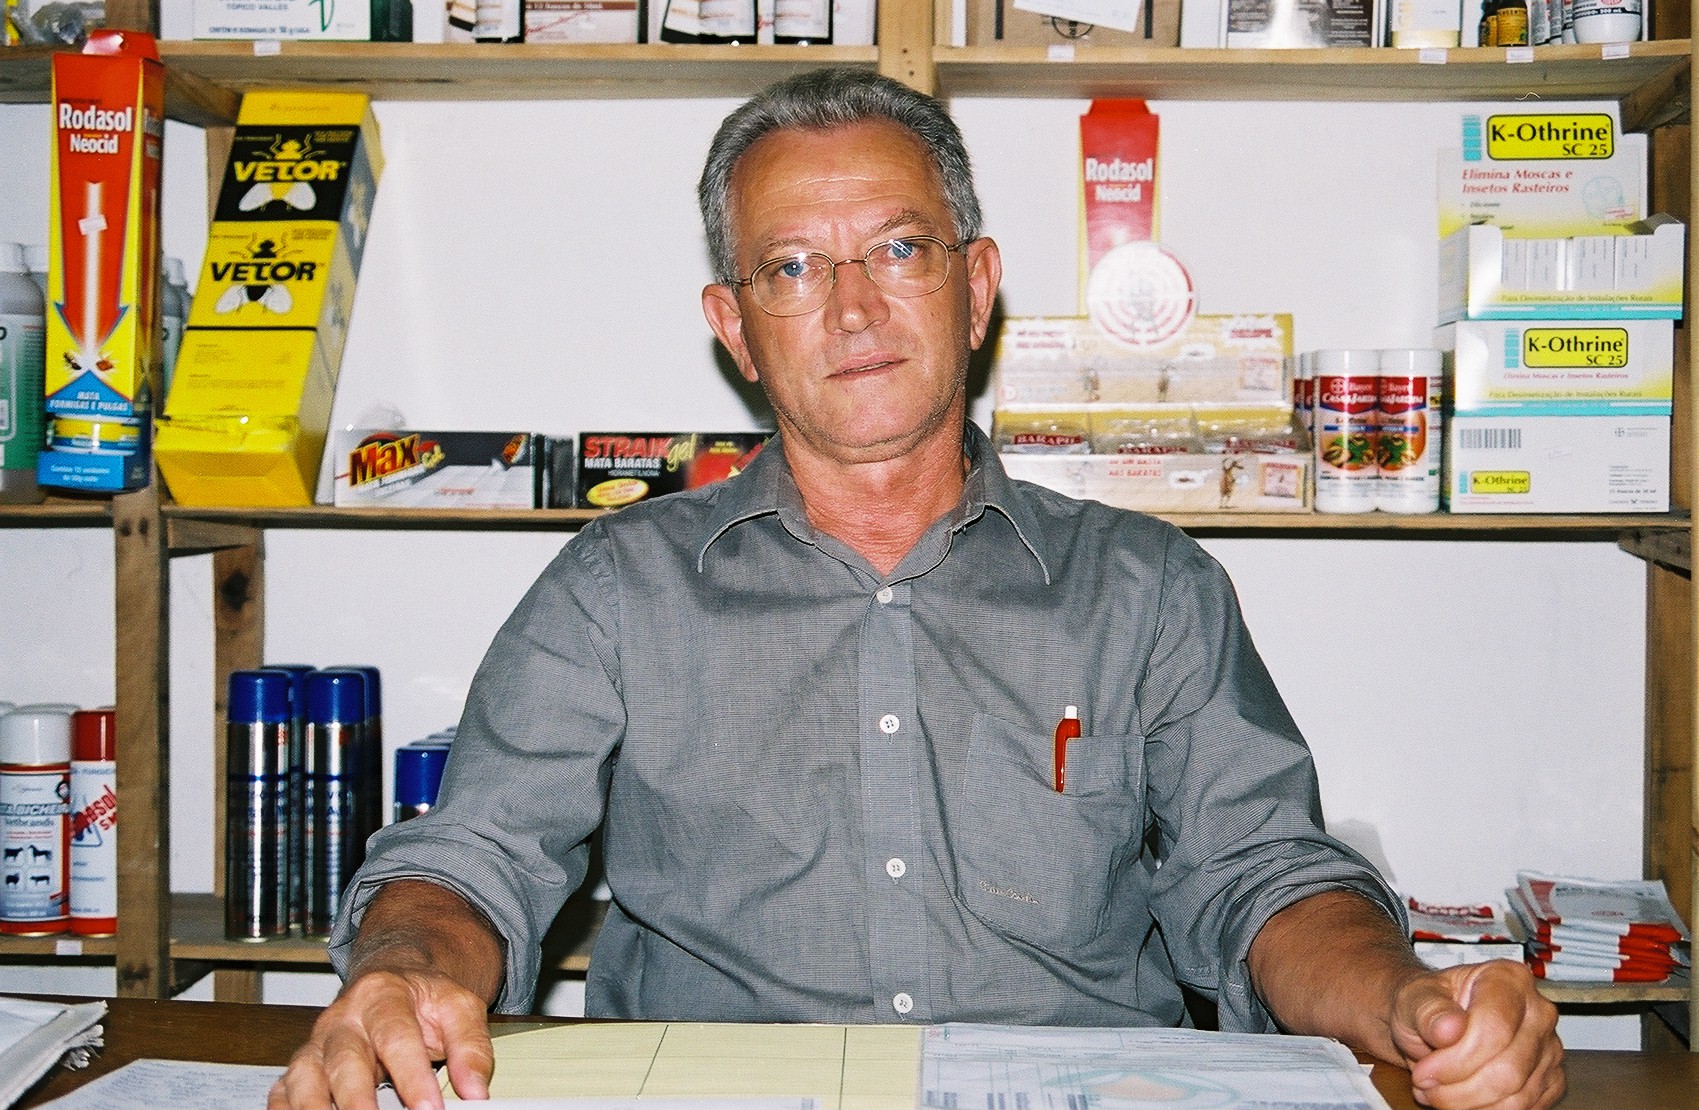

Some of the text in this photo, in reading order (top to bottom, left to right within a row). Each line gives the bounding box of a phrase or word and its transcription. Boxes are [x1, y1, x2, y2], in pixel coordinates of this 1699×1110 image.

[60, 103, 132, 132] Rodasol
[1492, 122, 1608, 142] K-Othrine
[70, 133, 118, 154] Neocid
[1563, 143, 1608, 156] SC 25
[233, 160, 340, 182] VETOR
[1085, 157, 1154, 182] Rodasol
[1462, 168, 1510, 180] Elimina
[1515, 168, 1561, 180] Moscas
[1462, 181, 1570, 194] Insetos Rasteiros
[211, 261, 316, 281] VETOR
[1528, 335, 1623, 352] K-Othrine
[1586, 354, 1623, 366] SC 25
[584, 436, 672, 459] STRAIK
[349, 433, 420, 488] Max
[584, 458, 661, 469] MATA BARATAS
